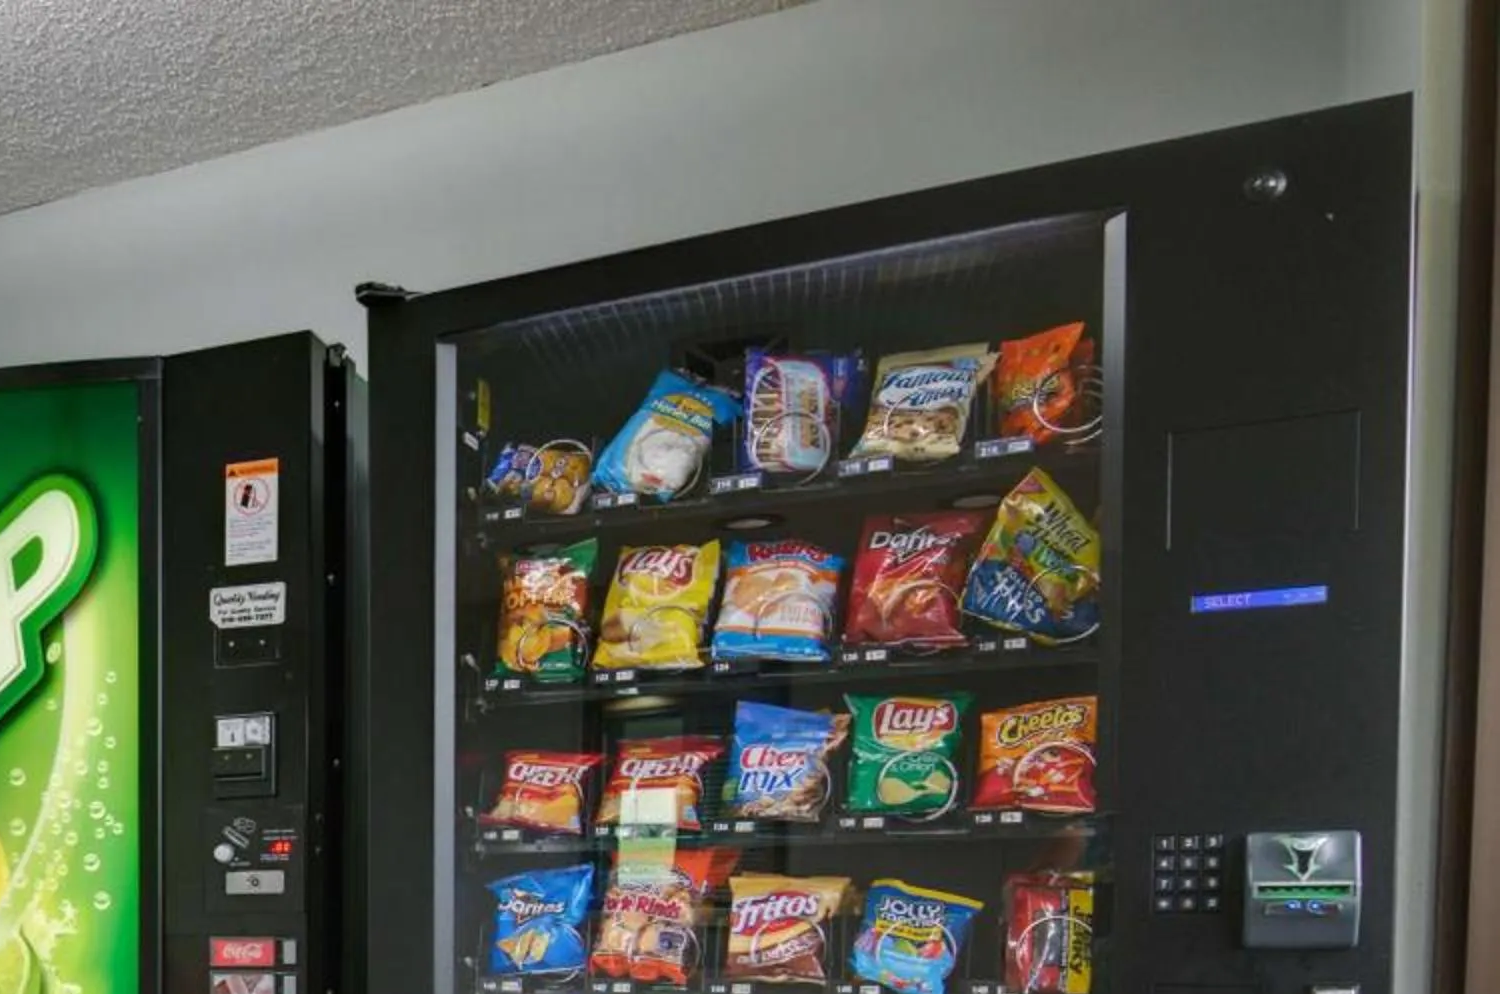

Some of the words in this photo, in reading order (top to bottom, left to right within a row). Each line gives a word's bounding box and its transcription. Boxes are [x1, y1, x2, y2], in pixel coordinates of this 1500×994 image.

[884, 365, 975, 391] Famous
[902, 387, 966, 408] Amos
[1202, 593, 1252, 609] SELECT
[740, 743, 806, 768] Chex
[733, 892, 819, 930] Fritos
[879, 895, 943, 918] JOLLY
